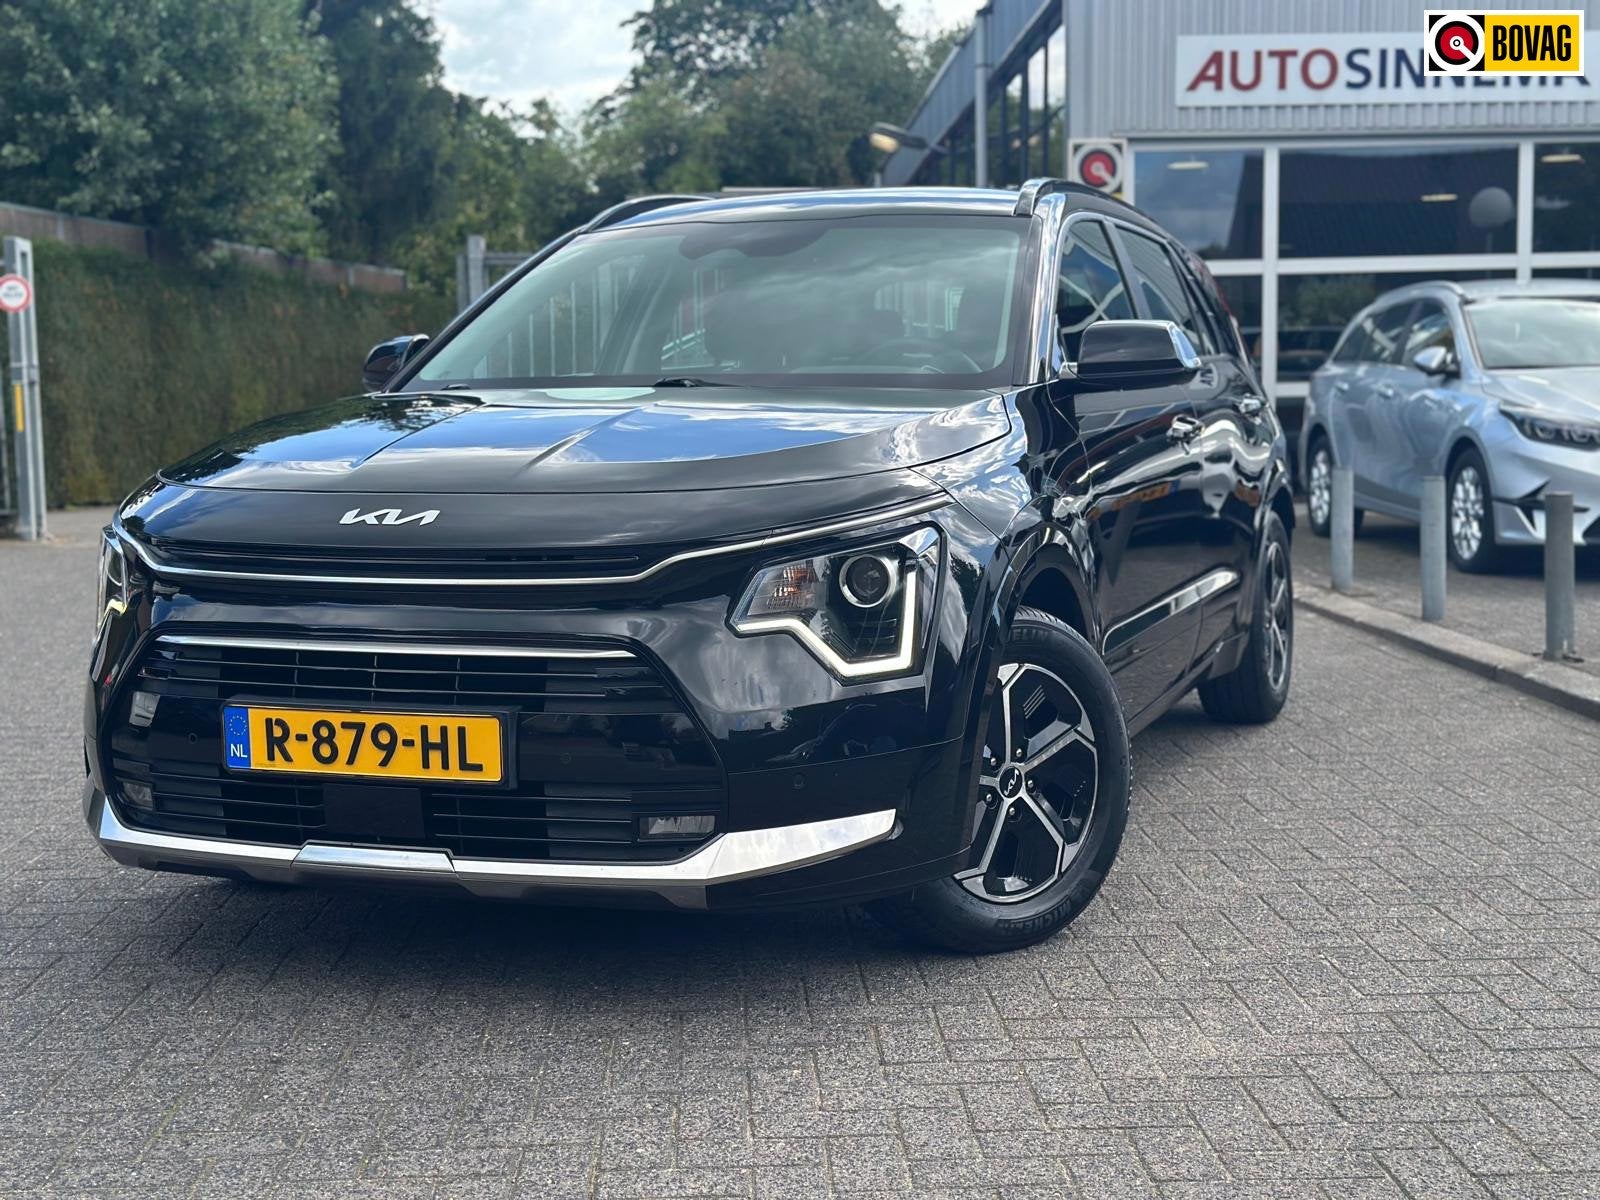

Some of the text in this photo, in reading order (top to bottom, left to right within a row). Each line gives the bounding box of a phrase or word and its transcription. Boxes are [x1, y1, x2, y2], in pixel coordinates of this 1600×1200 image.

[1186, 48, 1591, 92] AUTOSIN
[339, 508, 441, 526] KIA
[230, 743, 248, 759] NL
[264, 716, 484, 772] R-879-HL
